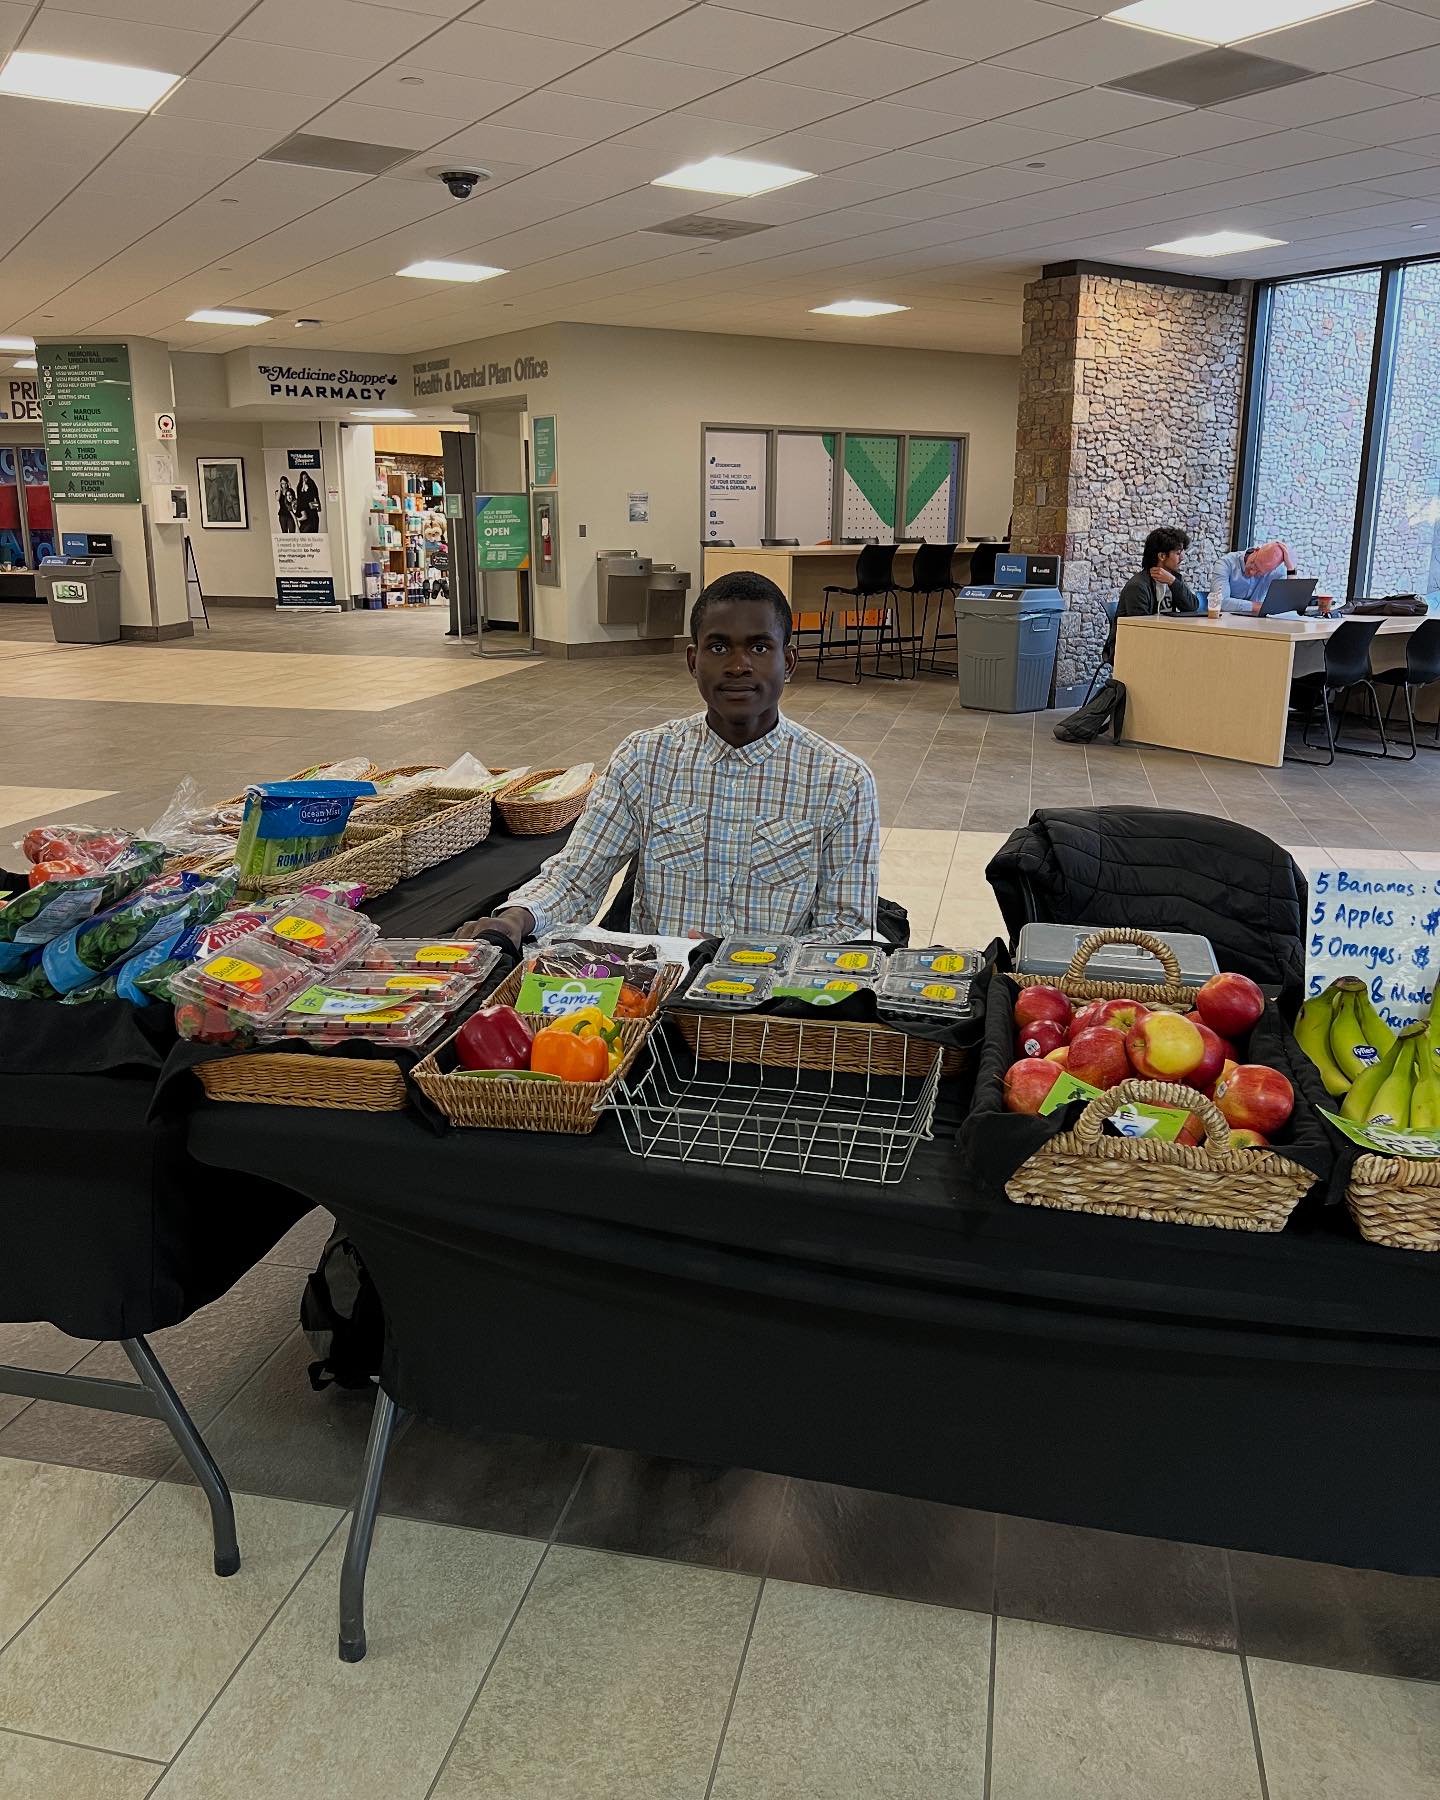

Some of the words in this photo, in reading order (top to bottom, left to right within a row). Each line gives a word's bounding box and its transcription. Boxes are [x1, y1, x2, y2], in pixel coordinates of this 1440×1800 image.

[267, 366, 336, 381] Medicine
[414, 373, 442, 396] Health
[445, 372, 452, 391] &
[454, 365, 486, 390] Dental
[488, 362, 512, 385] Plan
[514, 356, 548, 381] Office
[9, 382, 38, 400] PRI
[270, 384, 386, 400] PHARMACY
[12, 401, 42, 419] DES
[484, 527, 510, 536] OPEN
[56, 585, 84, 598] USSU
[301, 809, 325, 819] Ocean
[326, 808, 340, 816] Mist
[277, 850, 317, 867] ROMAINE
[1316, 872, 1330, 894] 5
[1311, 902, 1326, 925] 5
[1335, 904, 1393, 929] Apples
[1311, 933, 1325, 956] 5
[1329, 937, 1394, 969] Oranges
[1309, 976, 1326, 996] 5
[549, 994, 600, 1004] Carrots
